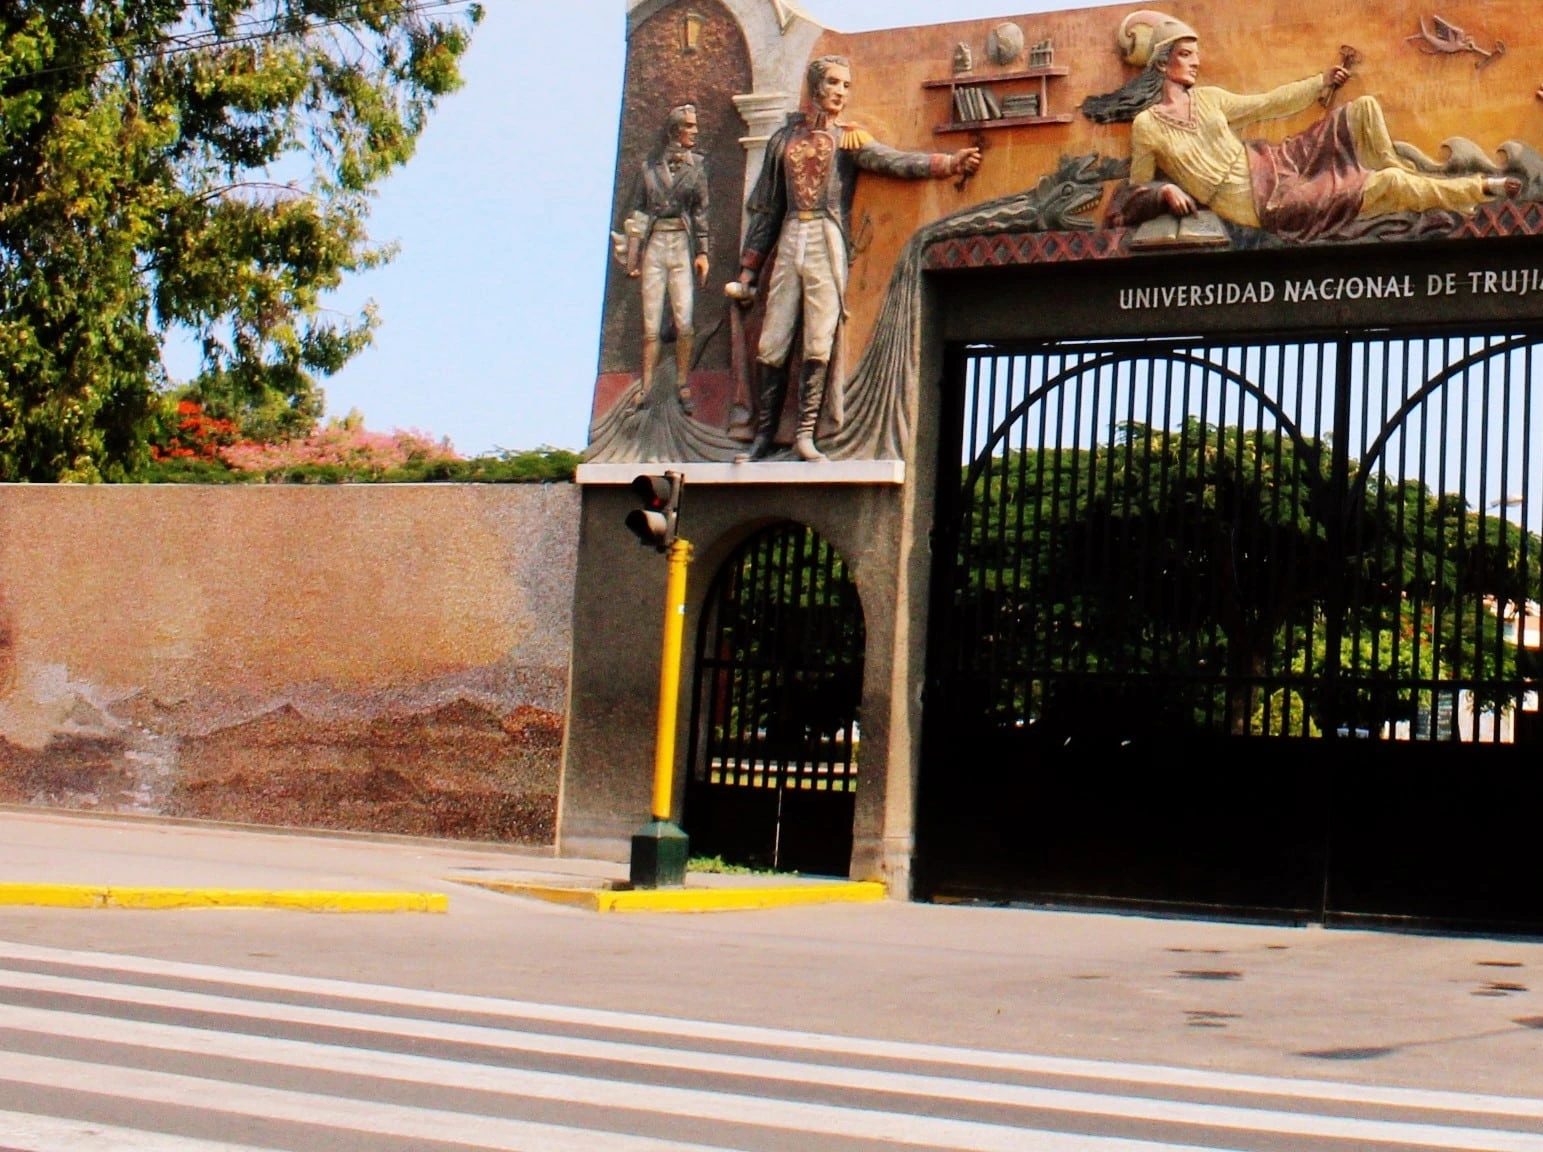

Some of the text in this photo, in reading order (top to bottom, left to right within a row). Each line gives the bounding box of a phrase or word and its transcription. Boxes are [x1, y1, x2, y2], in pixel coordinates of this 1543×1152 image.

[1119, 280, 1275, 310] UNIVERSIDAD
[1284, 275, 1415, 303] NACIONAL
[1427, 273, 1457, 296] DE
